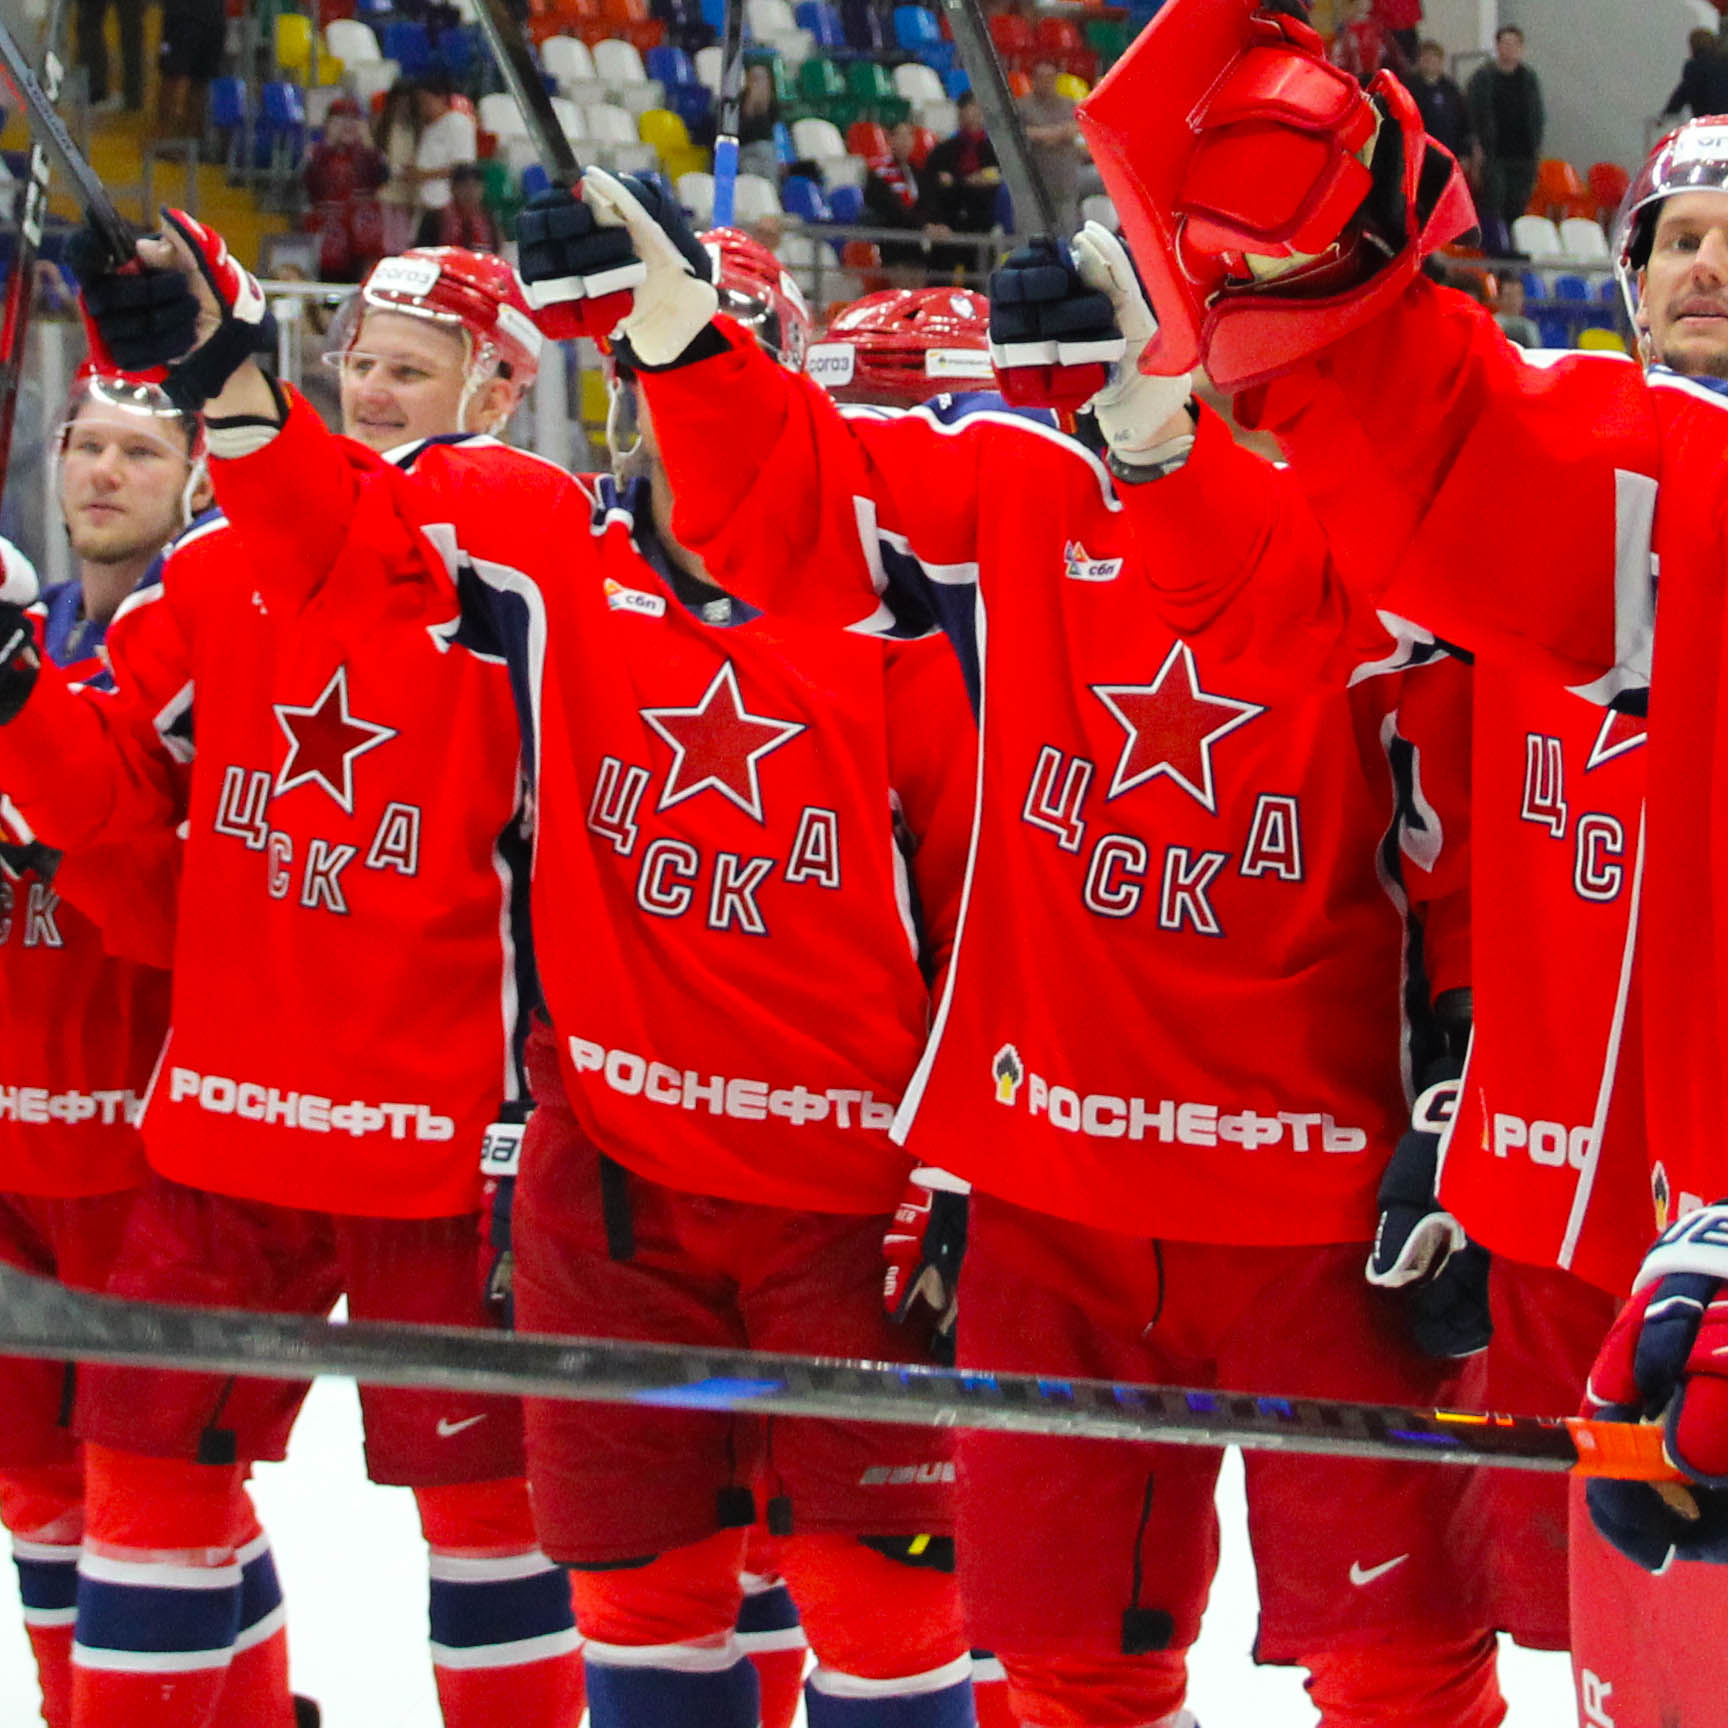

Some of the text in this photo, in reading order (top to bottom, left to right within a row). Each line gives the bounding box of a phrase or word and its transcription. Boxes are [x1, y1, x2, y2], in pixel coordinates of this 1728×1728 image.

[214, 765, 421, 916] ЦСКА
[587, 755, 843, 936] ЦСКА
[1021, 744, 1304, 937] ЦСКА
[1521, 734, 1623, 902] ЦС
[169, 1066, 455, 1141] РОСНЕФТЬ
[569, 1035, 898, 1130] РОСНЕФТЬ
[1028, 1072, 1368, 1154] РОСНЕФТЬ
